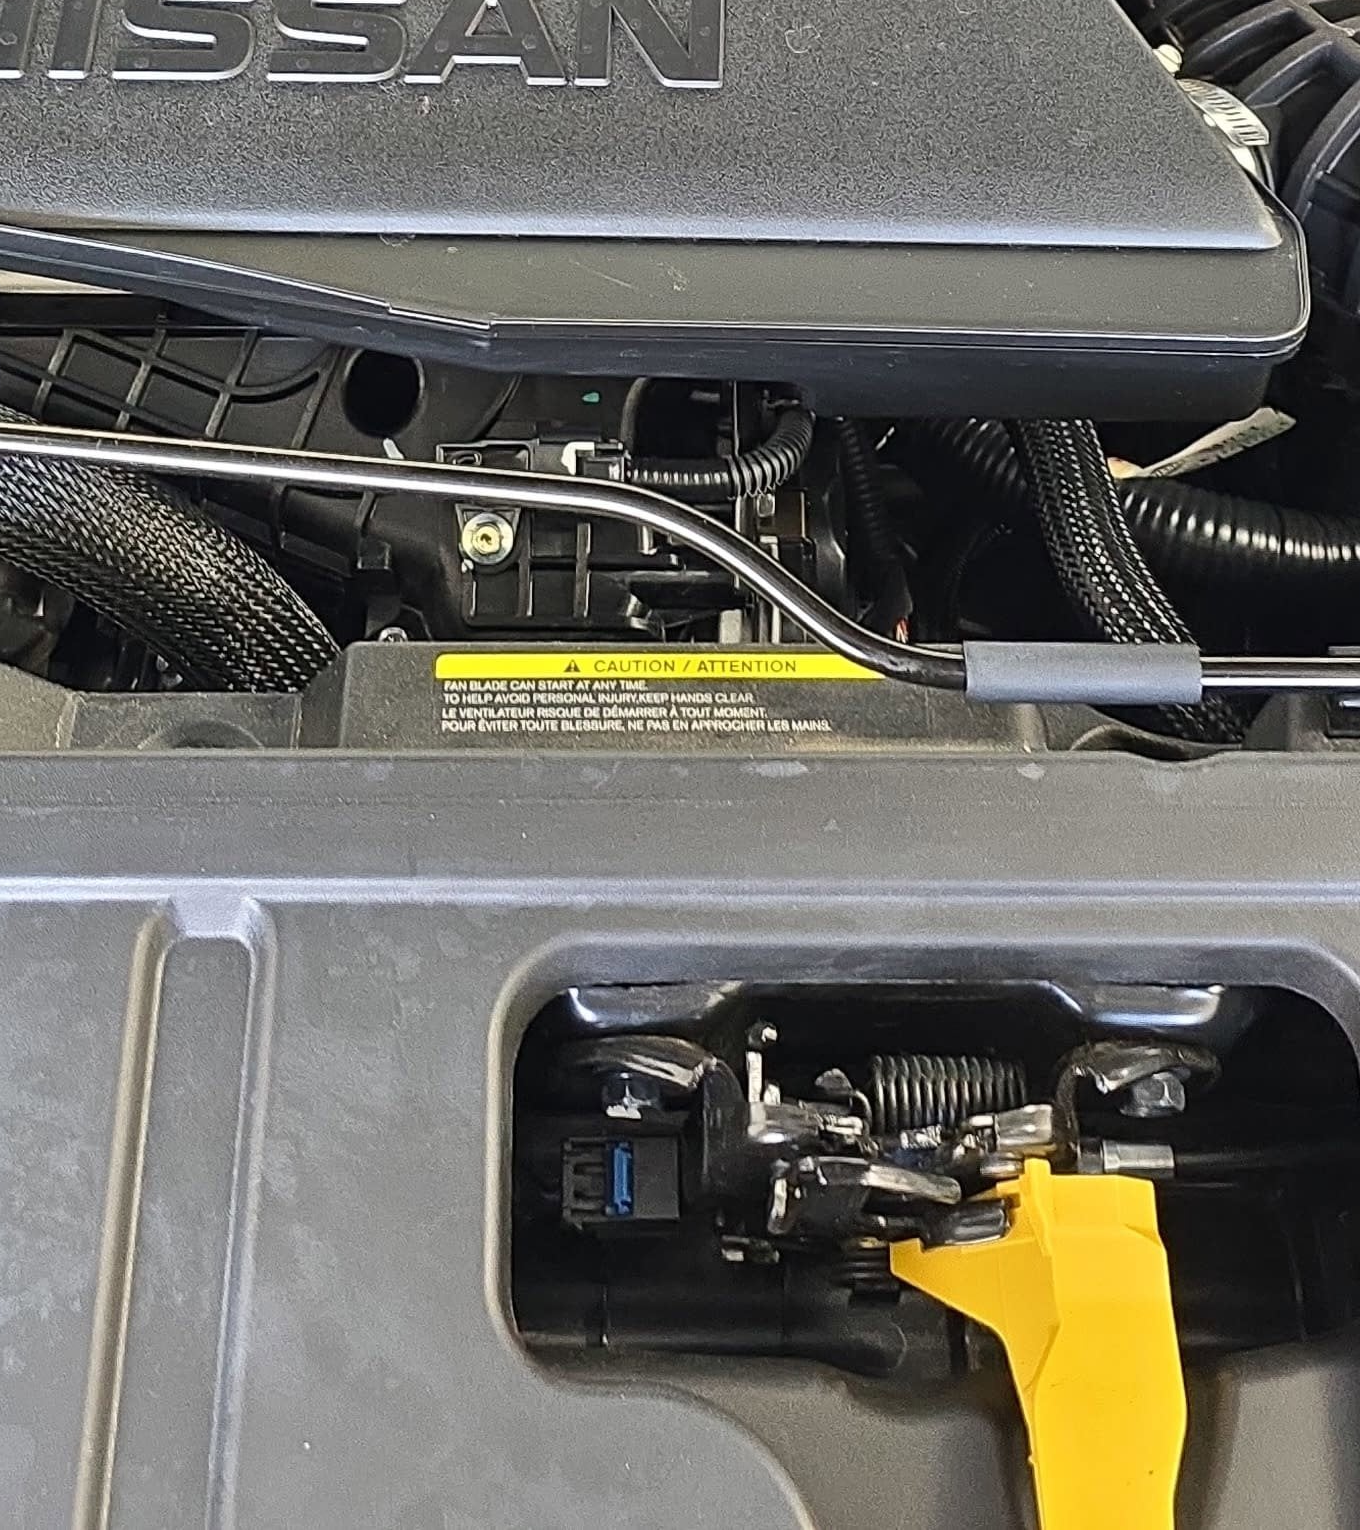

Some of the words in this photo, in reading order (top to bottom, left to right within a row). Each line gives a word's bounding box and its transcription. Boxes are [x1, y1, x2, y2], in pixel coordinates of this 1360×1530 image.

[594, 659, 676, 673] CAUTION
[682, 659, 692, 673] /
[697, 659, 797, 673] ATTENTION
[444, 680, 467, 691] FAN
[469, 680, 508, 691] BLADE
[510, 680, 535, 691] CAN
[538, 680, 574, 691] START
[576, 680, 590, 691] AT
[592, 680, 617, 691] ANY
[619, 680, 648, 691] TIME.
[444, 692, 460, 704] TO
[462, 692, 493, 704] HELP
[494, 692, 530, 704] AVOID
[533, 692, 595, 704] PERSONAL
[671, 692, 712, 704] HANDS
[442, 707, 457, 718] LE
[459, 707, 535, 718] VENTILATEUR
[537, 707, 580, 718] RISQUE
[583, 707, 600, 718] DE
[603, 705, 668, 718] DÉMARRER
[669, 704, 679, 718] À
[680, 707, 711, 718] TOUT
[713, 707, 768, 718] MOMENT.
[442, 720, 476, 731] POUR
[520, 720, 559, 731] TOUTE
[628, 720, 644, 731] NE
[646, 720, 670, 731] PAS
[673, 720, 688, 731] EN
[767, 720, 790, 731] LES
